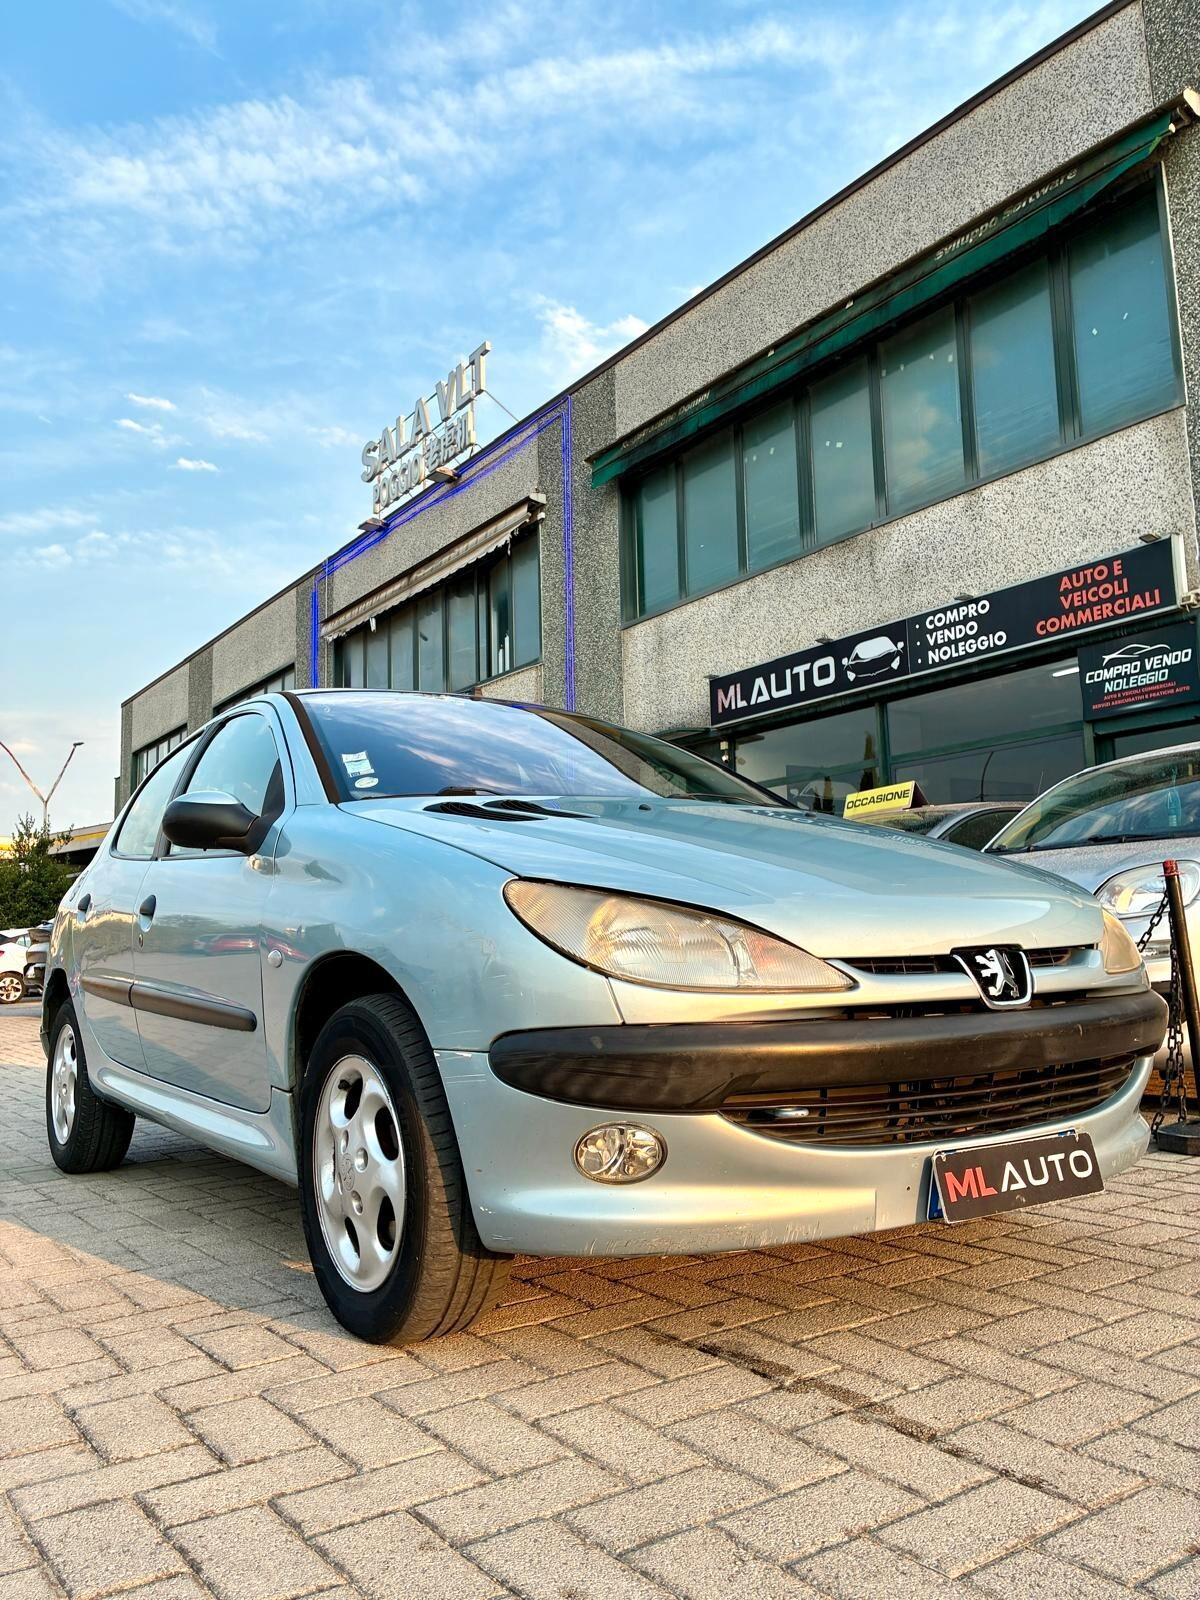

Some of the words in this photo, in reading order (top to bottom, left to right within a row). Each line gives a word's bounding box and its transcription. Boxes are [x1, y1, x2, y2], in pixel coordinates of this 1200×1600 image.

[361, 397, 432, 483] SALA
[435, 340, 492, 422] VLT
[373, 453, 426, 514] POGGIO
[1059, 566, 1109, 592] AUTO
[1113, 559, 1123, 576] E
[1060, 578, 1128, 610] VEICOLI
[926, 600, 990, 630] COMPRO
[1036, 589, 1161, 636] COMMERCIALI
[926, 621, 978, 647] VENDO
[928, 631, 1007, 665] NOLEGGIO
[1085, 660, 1141, 684] COMPRO
[1145, 648, 1192, 671] VENDO
[1104, 669, 1169, 693] NOLEGGIO
[1142, 681, 1176, 692] COMMERCIALI
[846, 789, 911, 810] OCCASIONE
